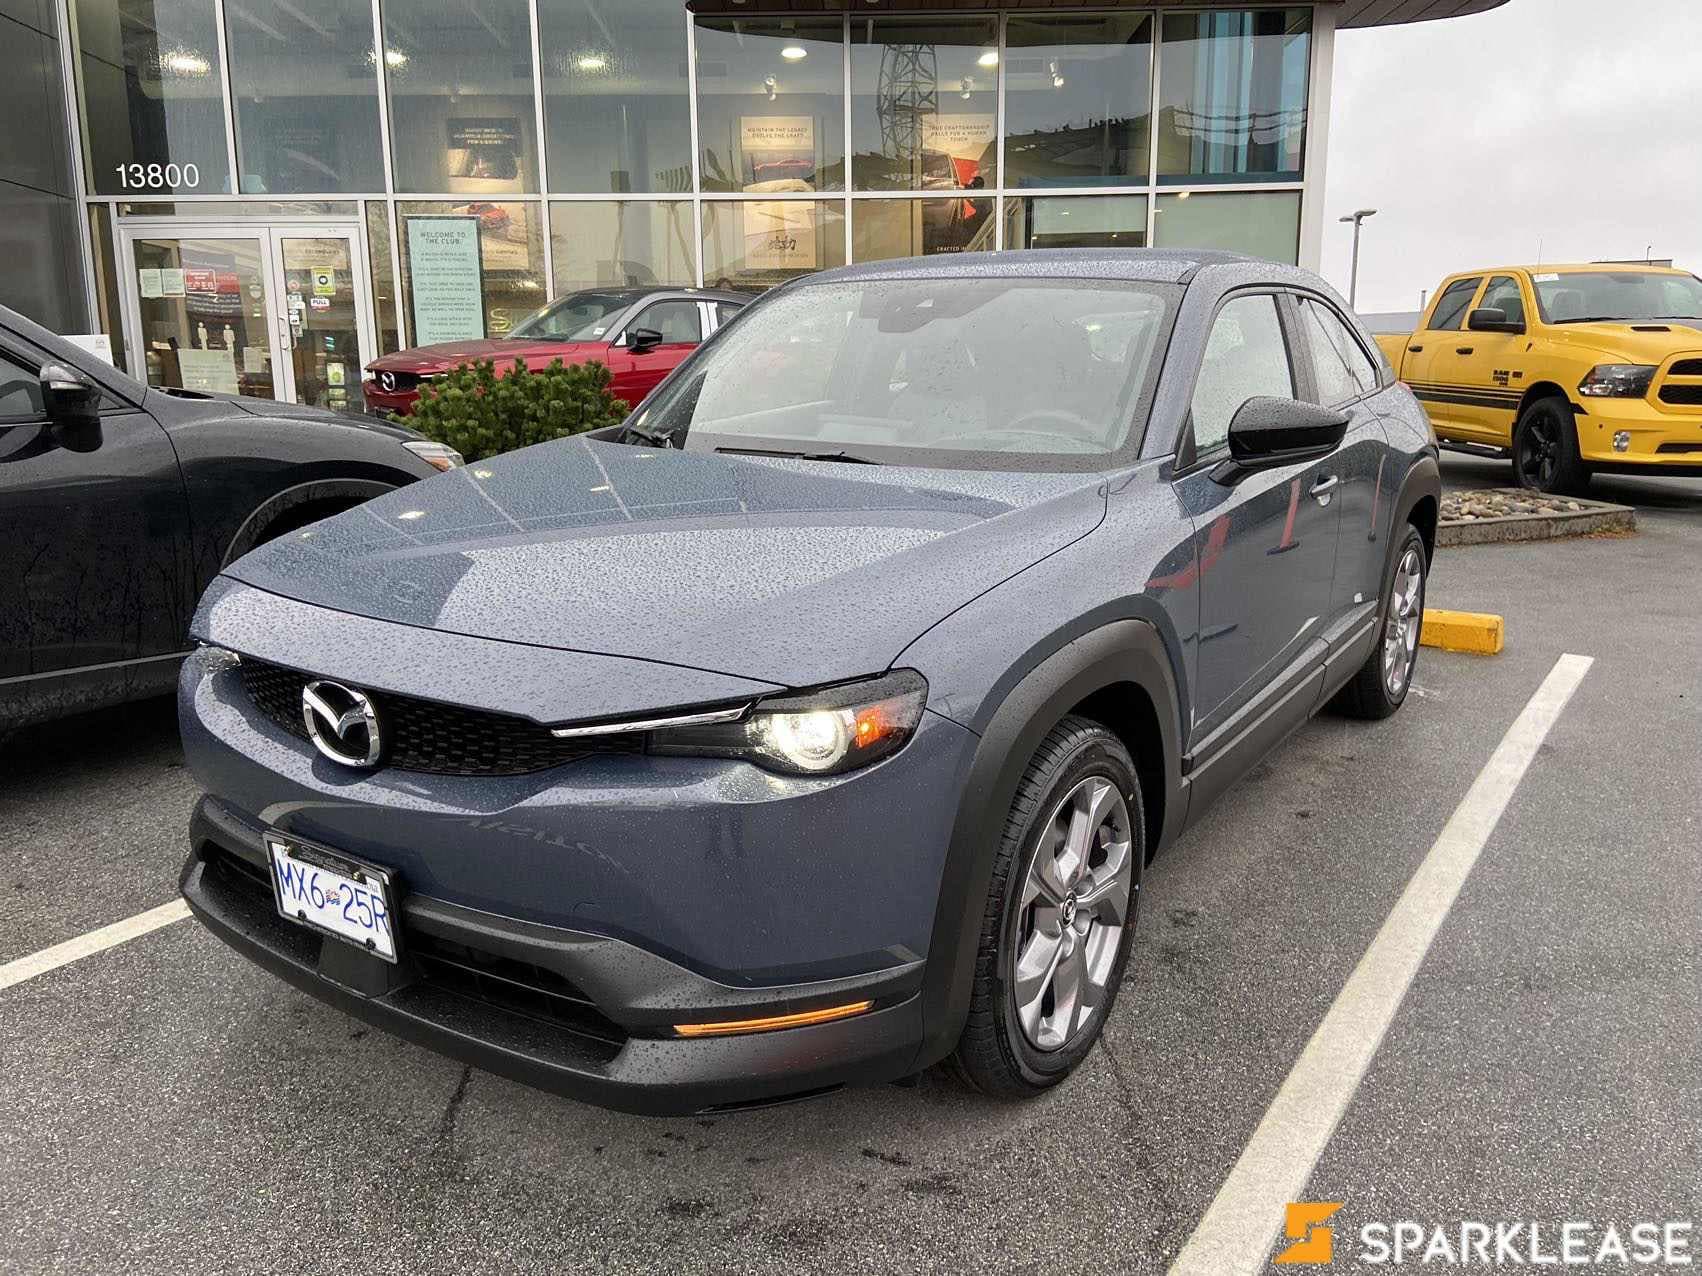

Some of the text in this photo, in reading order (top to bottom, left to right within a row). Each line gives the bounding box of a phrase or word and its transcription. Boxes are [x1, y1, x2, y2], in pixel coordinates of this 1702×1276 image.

[115, 163, 200, 188] 13800
[277, 857, 326, 910] MX6
[339, 882, 391, 937] 25R
